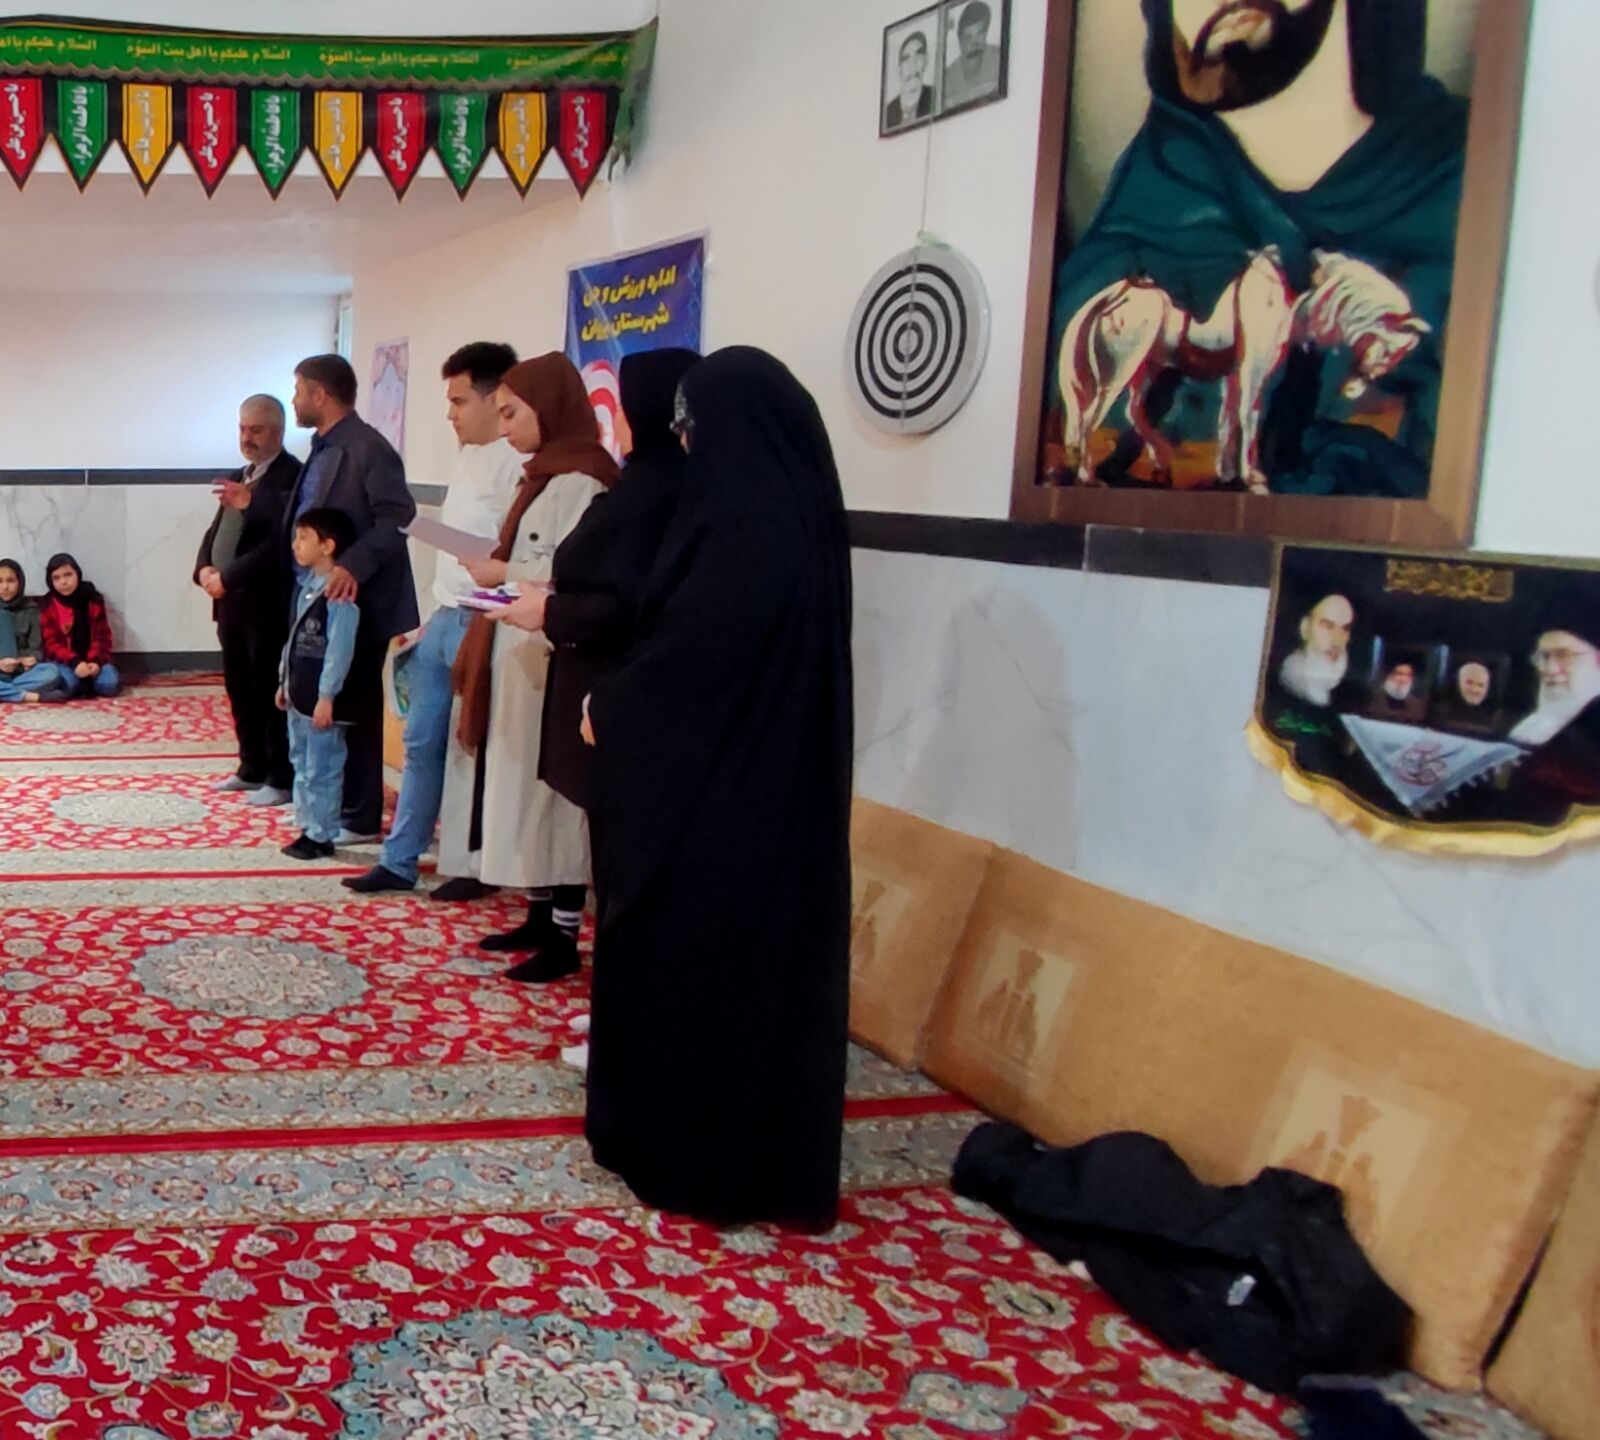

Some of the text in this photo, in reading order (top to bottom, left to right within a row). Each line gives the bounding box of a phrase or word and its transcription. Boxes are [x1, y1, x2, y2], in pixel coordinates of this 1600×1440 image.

[610, 274, 646, 303] ورزش
[647, 265, 677, 295] اداره
[611, 301, 670, 337] شهرستان
